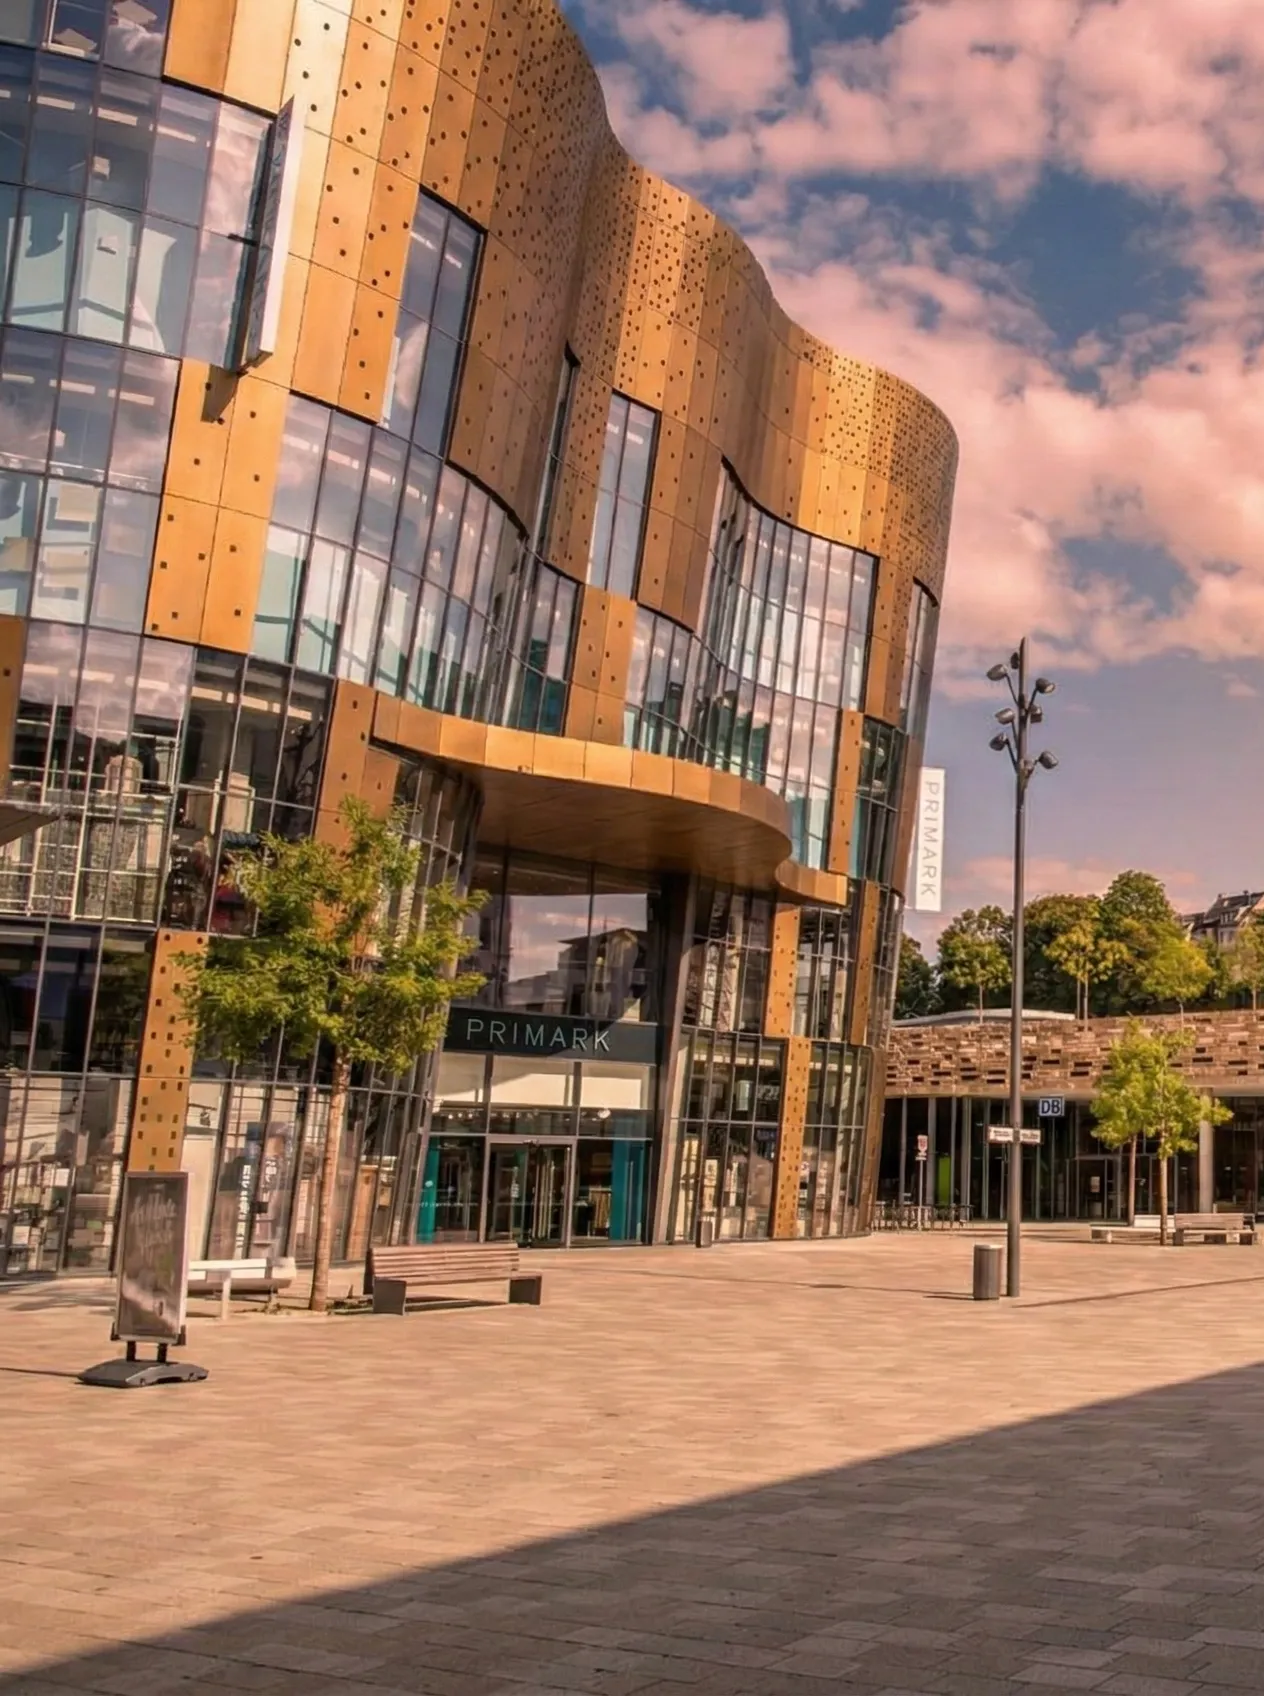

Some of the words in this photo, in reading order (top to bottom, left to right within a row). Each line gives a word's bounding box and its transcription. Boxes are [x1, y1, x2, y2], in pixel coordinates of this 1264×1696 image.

[922, 781, 940, 896] PRIMARK
[466, 1018, 611, 1052] PRIMARK
[1042, 1099, 1060, 1114] DB
